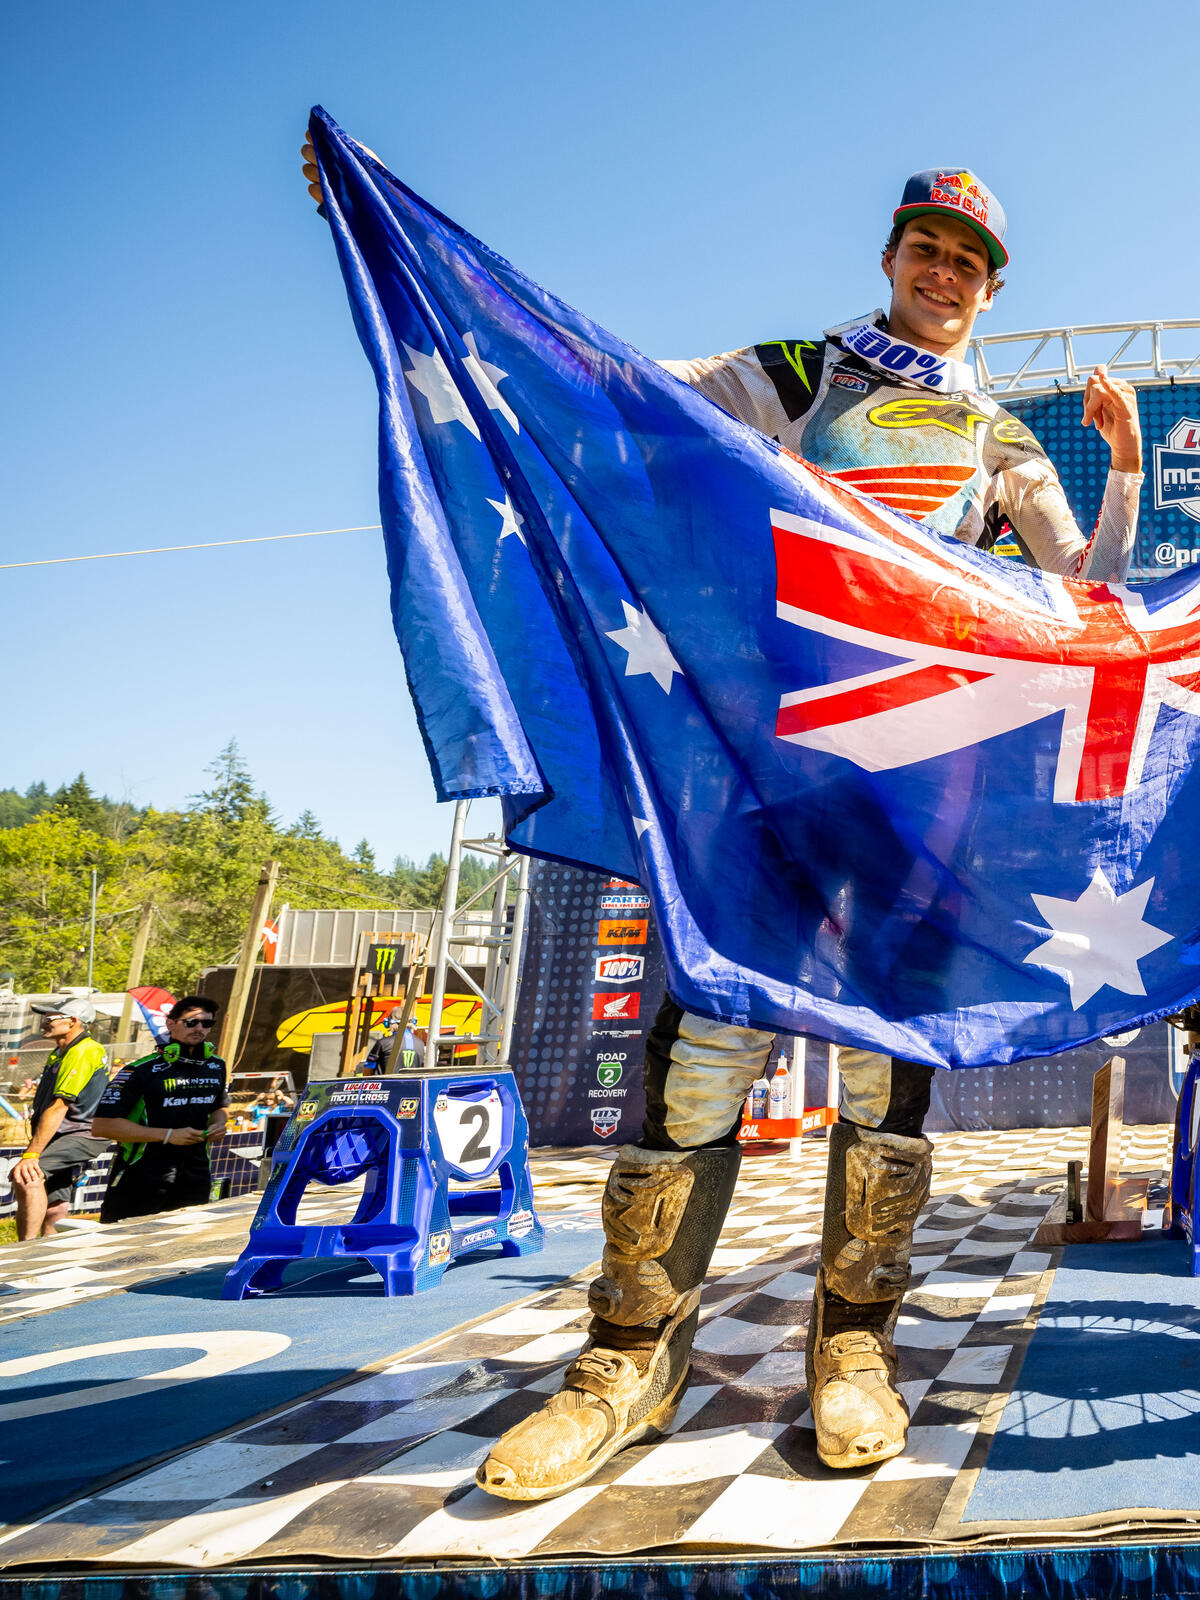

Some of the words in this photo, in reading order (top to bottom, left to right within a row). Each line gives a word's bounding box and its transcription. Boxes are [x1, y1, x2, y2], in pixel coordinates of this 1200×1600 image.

[930, 187, 962, 206] Red
[963, 196, 989, 225] Bull
[835, 375, 866, 391] 100%
[602, 896, 649, 904] PARTS
[606, 926, 642, 938] KTM
[602, 960, 639, 977] 100%
[596, 1052, 627, 1061] ROAD
[603, 1069, 614, 1083] 2
[345, 1082, 369, 1091] LUCAS
[369, 1082, 381, 1090] OIL
[330, 1093, 390, 1102] MOTOCROSS
[588, 1089, 628, 1098] RECOVERY
[301, 1102, 316, 1114] 50
[401, 1100, 416, 1112] 50
[458, 1104, 491, 1164] 2
[739, 1124, 760, 1137] OIL
[431, 1235, 451, 1252] 50
